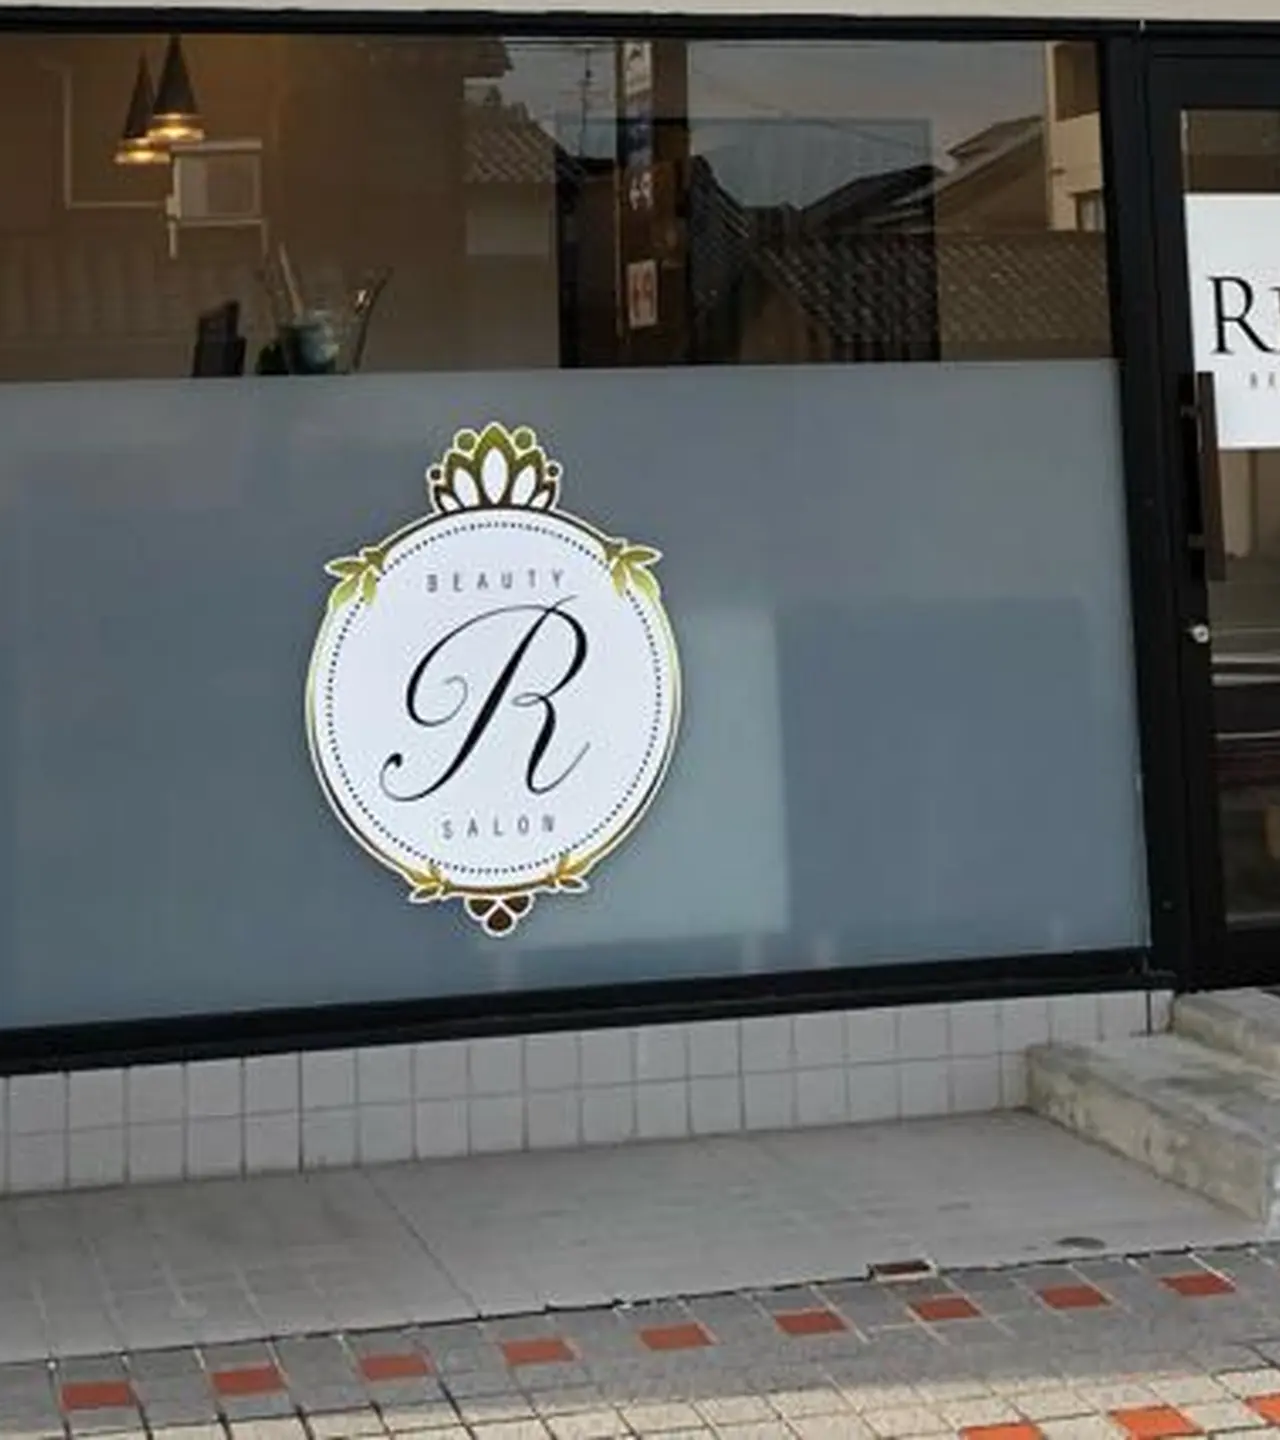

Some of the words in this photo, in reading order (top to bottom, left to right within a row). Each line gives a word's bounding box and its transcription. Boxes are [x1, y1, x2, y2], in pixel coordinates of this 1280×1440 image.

[426, 567, 566, 594] BEAUTY
[378, 594, 591, 803] R
[442, 814, 557, 840] SALON
